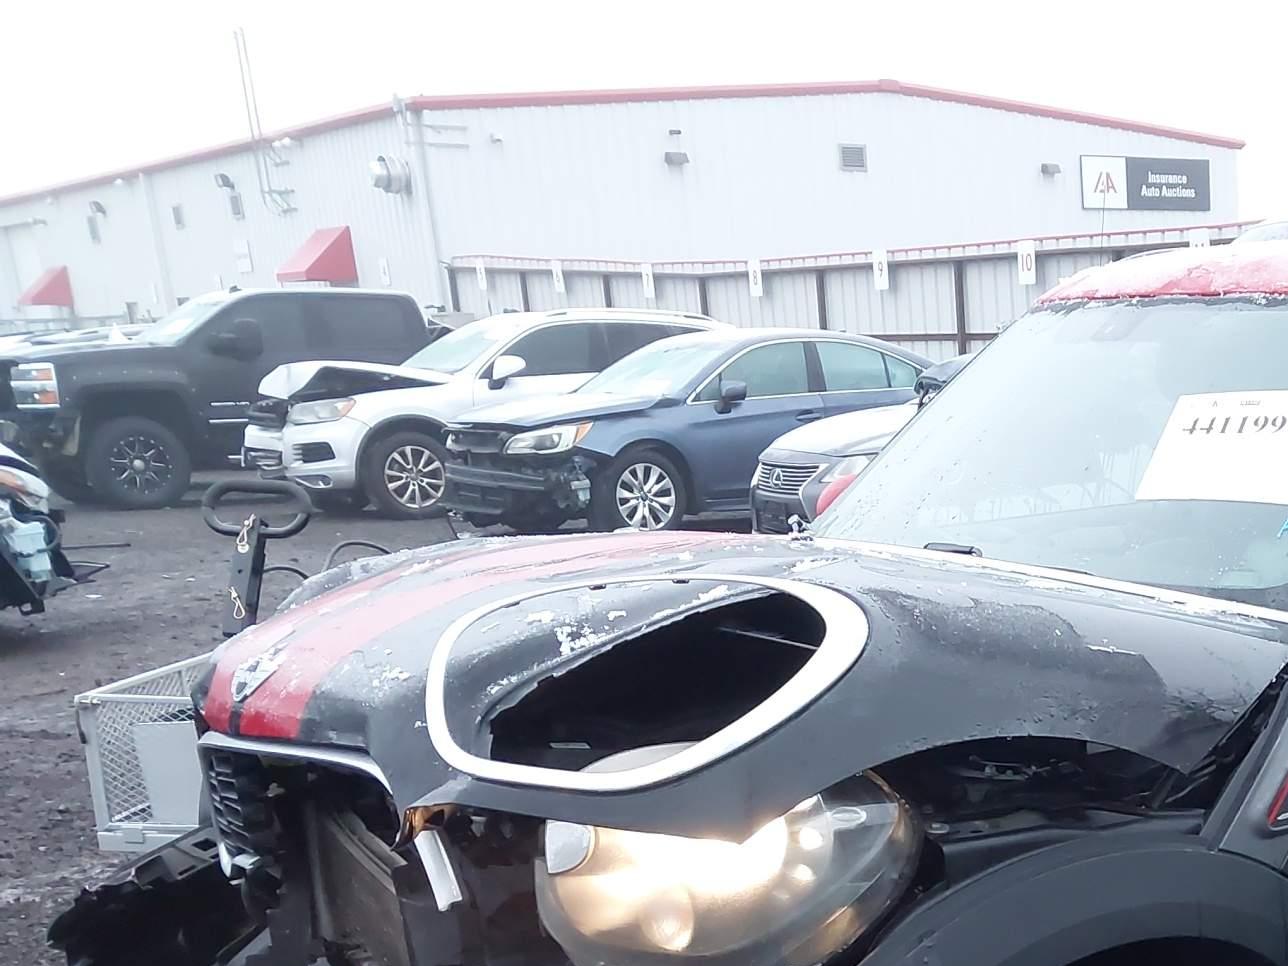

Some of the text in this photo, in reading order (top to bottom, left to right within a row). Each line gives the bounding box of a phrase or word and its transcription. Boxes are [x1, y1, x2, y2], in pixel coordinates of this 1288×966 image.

[1147, 171, 1188, 184] Insurance
[1140, 185, 1196, 198] Auto Auctions
[1020, 252, 1033, 273] 10
[752, 269, 759, 286] 8
